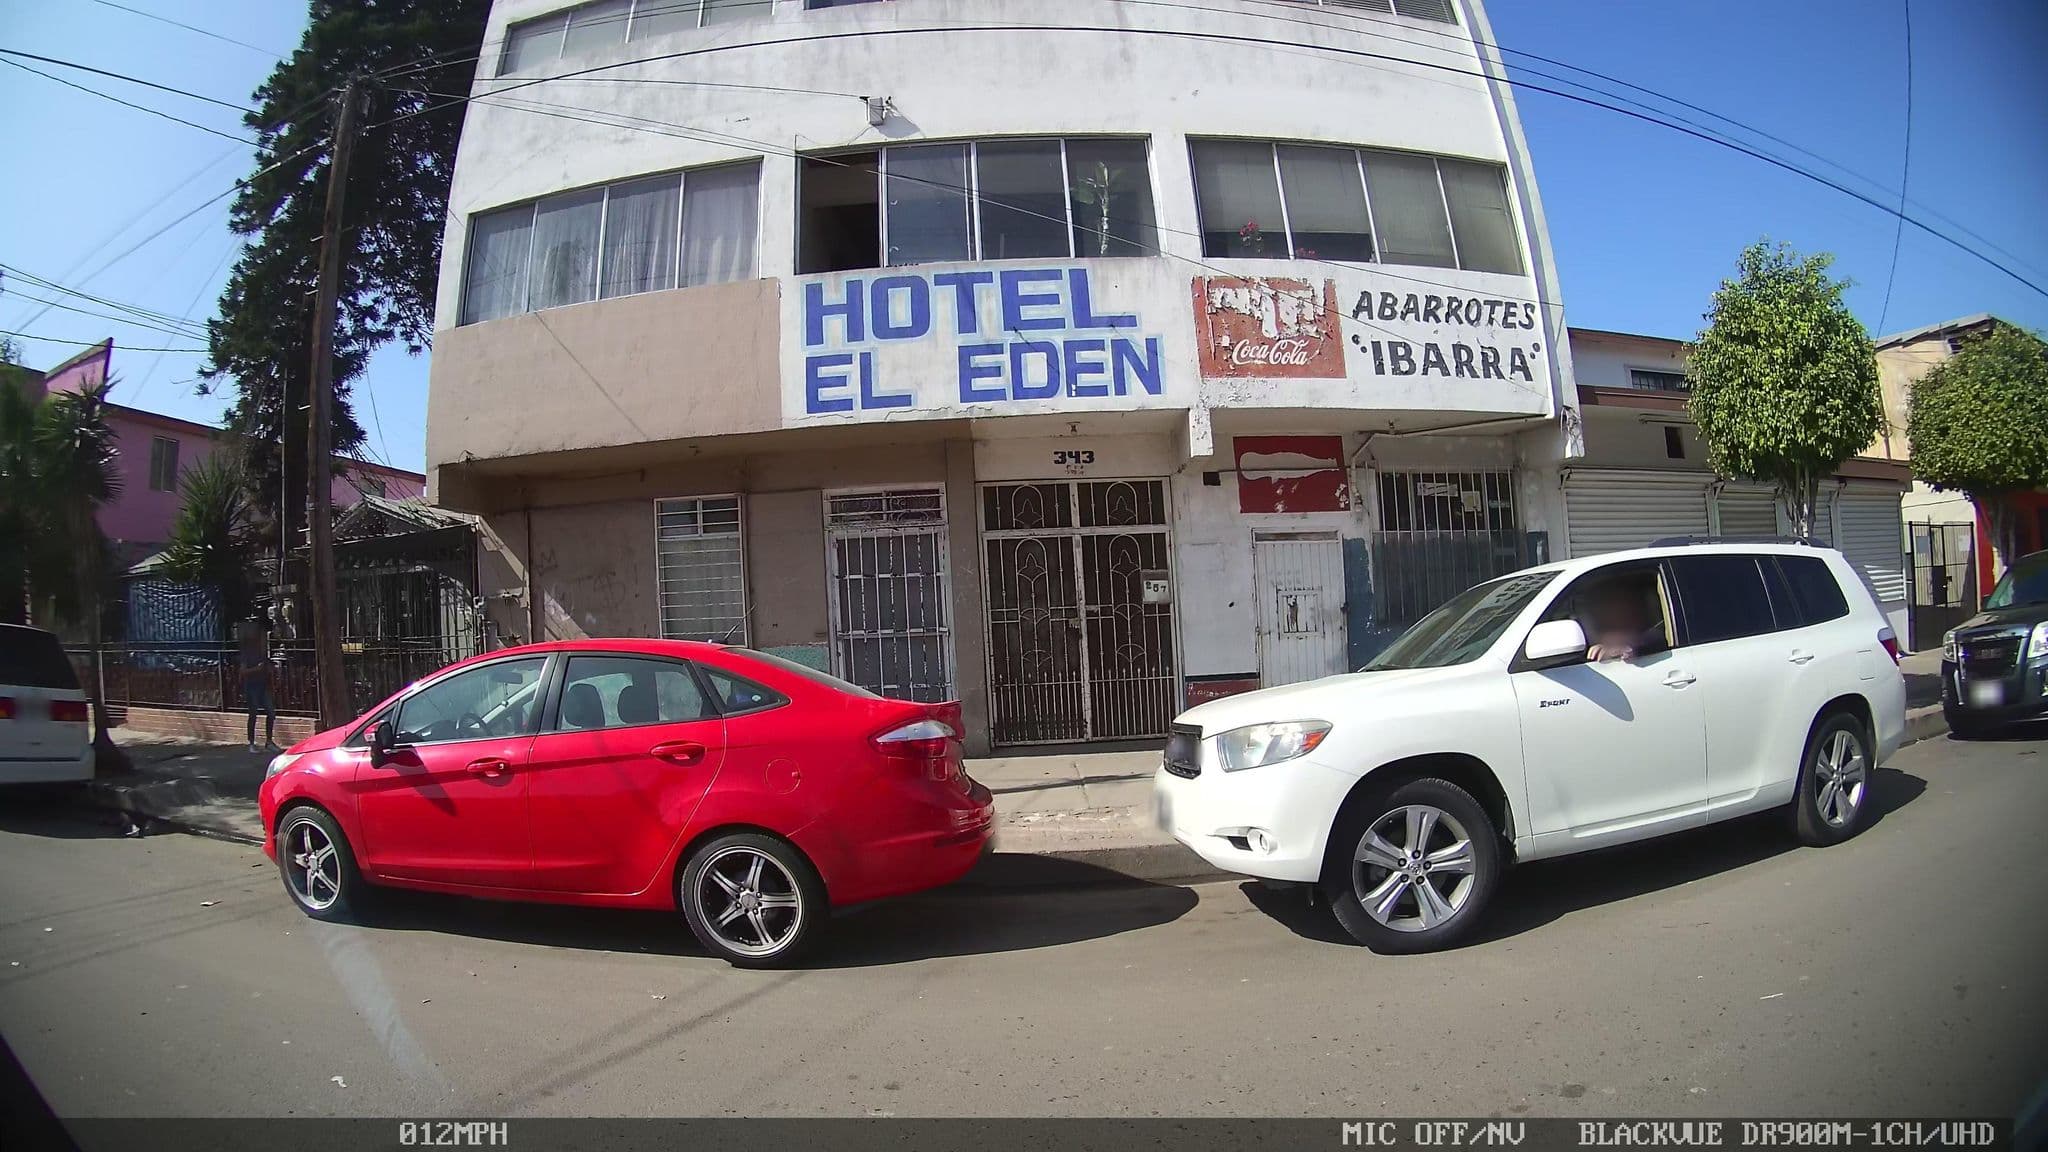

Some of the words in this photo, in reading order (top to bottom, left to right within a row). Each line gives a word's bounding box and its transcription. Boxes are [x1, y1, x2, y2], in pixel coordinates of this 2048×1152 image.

[805, 268, 1138, 346] HOTEL
[1352, 290, 1536, 330] ABARROTES
[805, 352, 913, 414] EL
[957, 337, 1162, 403] EDEN
[1053, 450, 1095, 464] 343
